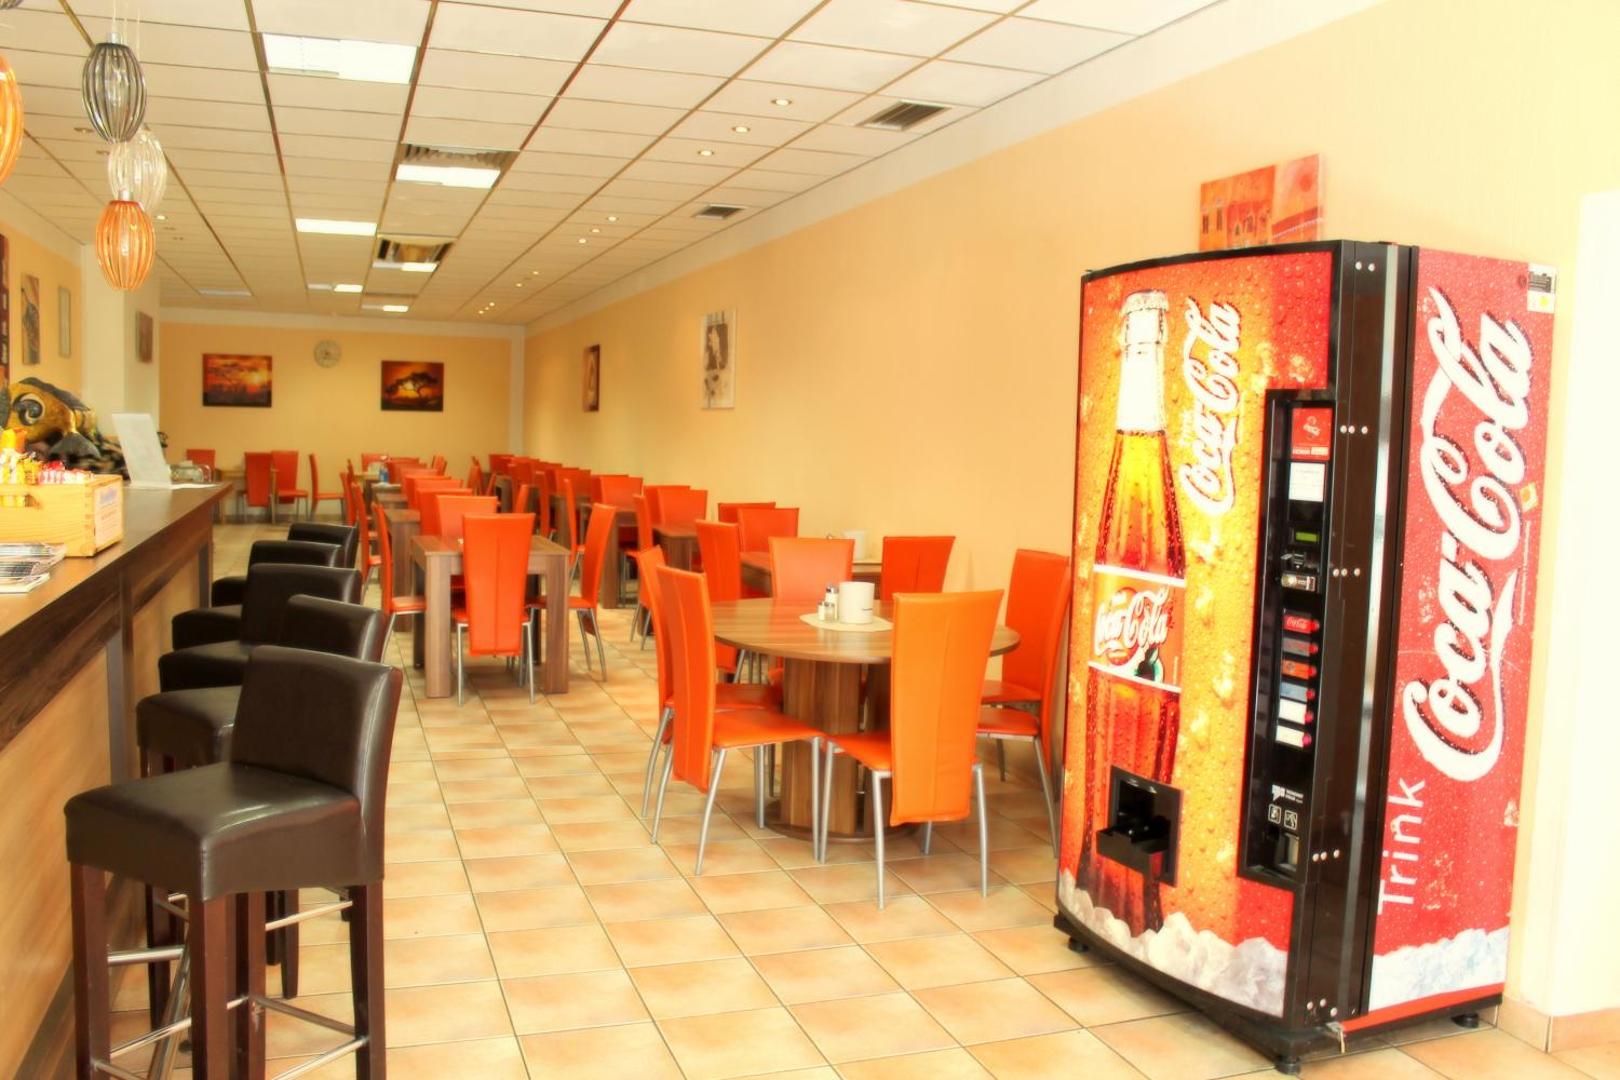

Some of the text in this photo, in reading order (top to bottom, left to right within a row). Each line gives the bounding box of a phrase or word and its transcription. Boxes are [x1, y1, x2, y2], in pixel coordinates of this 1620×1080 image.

[1179, 296, 1241, 515] Coca-Cola
[1403, 287, 1534, 782] Coca-Cola
[1377, 777, 1426, 915] Trink
